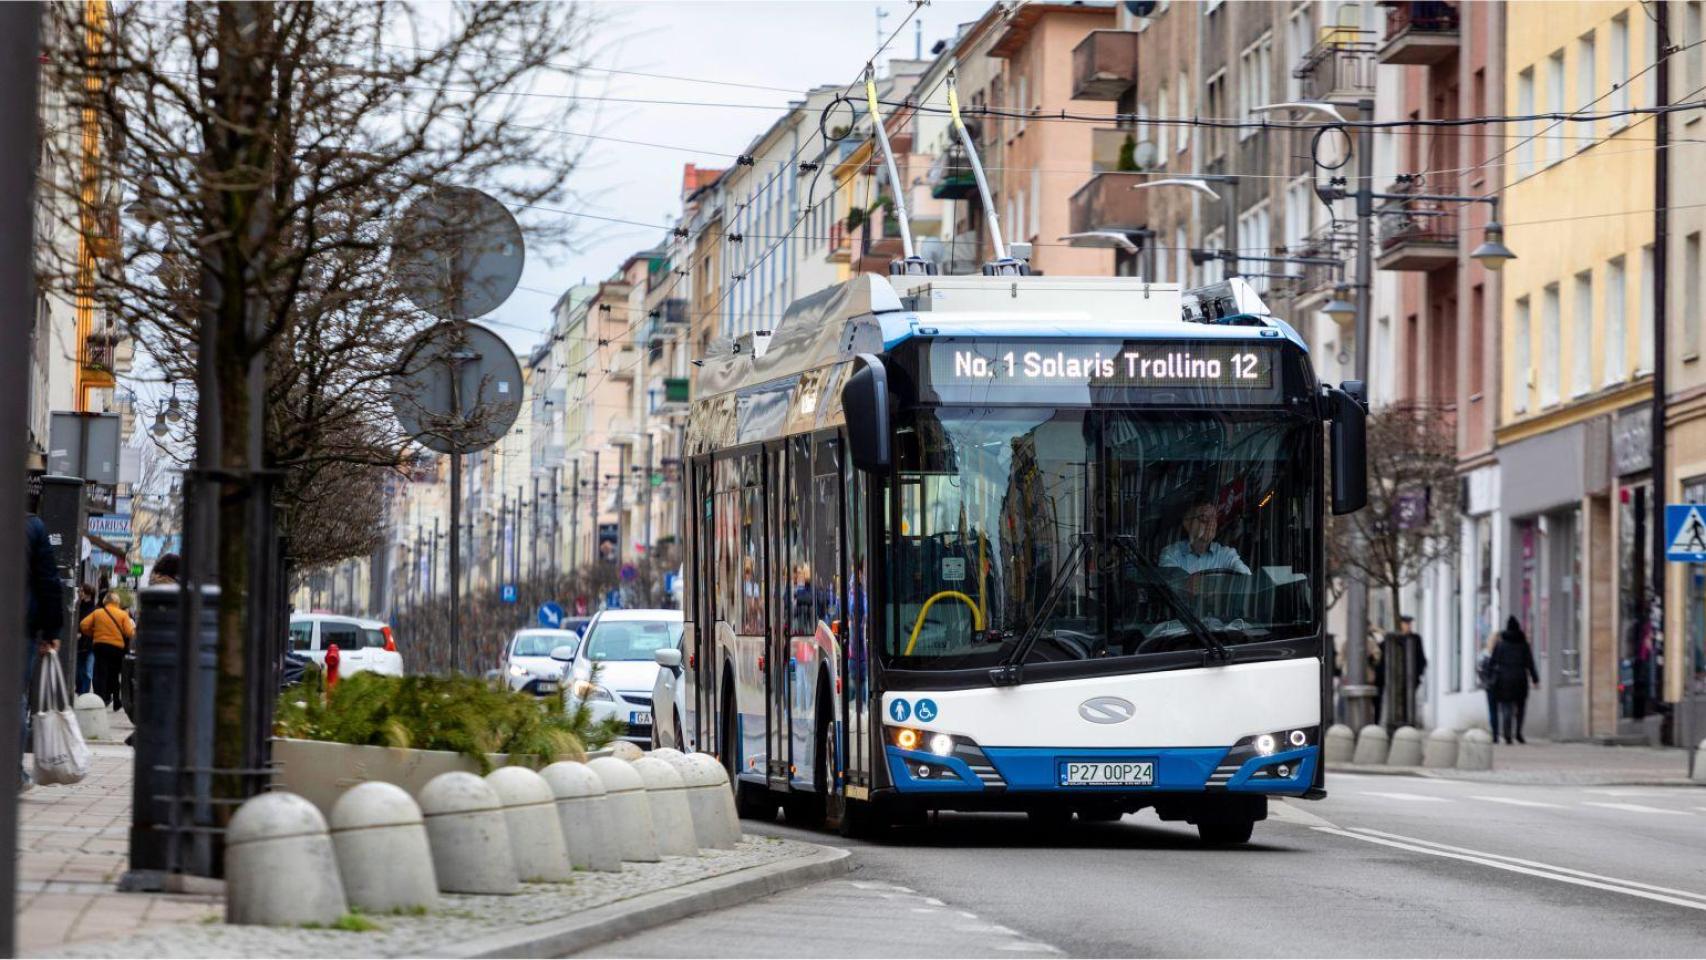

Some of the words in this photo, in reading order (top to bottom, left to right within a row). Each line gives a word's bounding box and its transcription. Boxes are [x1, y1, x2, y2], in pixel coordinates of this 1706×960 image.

[955, 351, 994, 377] No.
[1003, 351, 1015, 377] 1
[1023, 351, 1114, 378] Solaris
[1124, 352, 1221, 378] Trollino
[1230, 353, 1258, 379] 12
[637, 713, 650, 723] GA
[1069, 764, 1098, 780] P27
